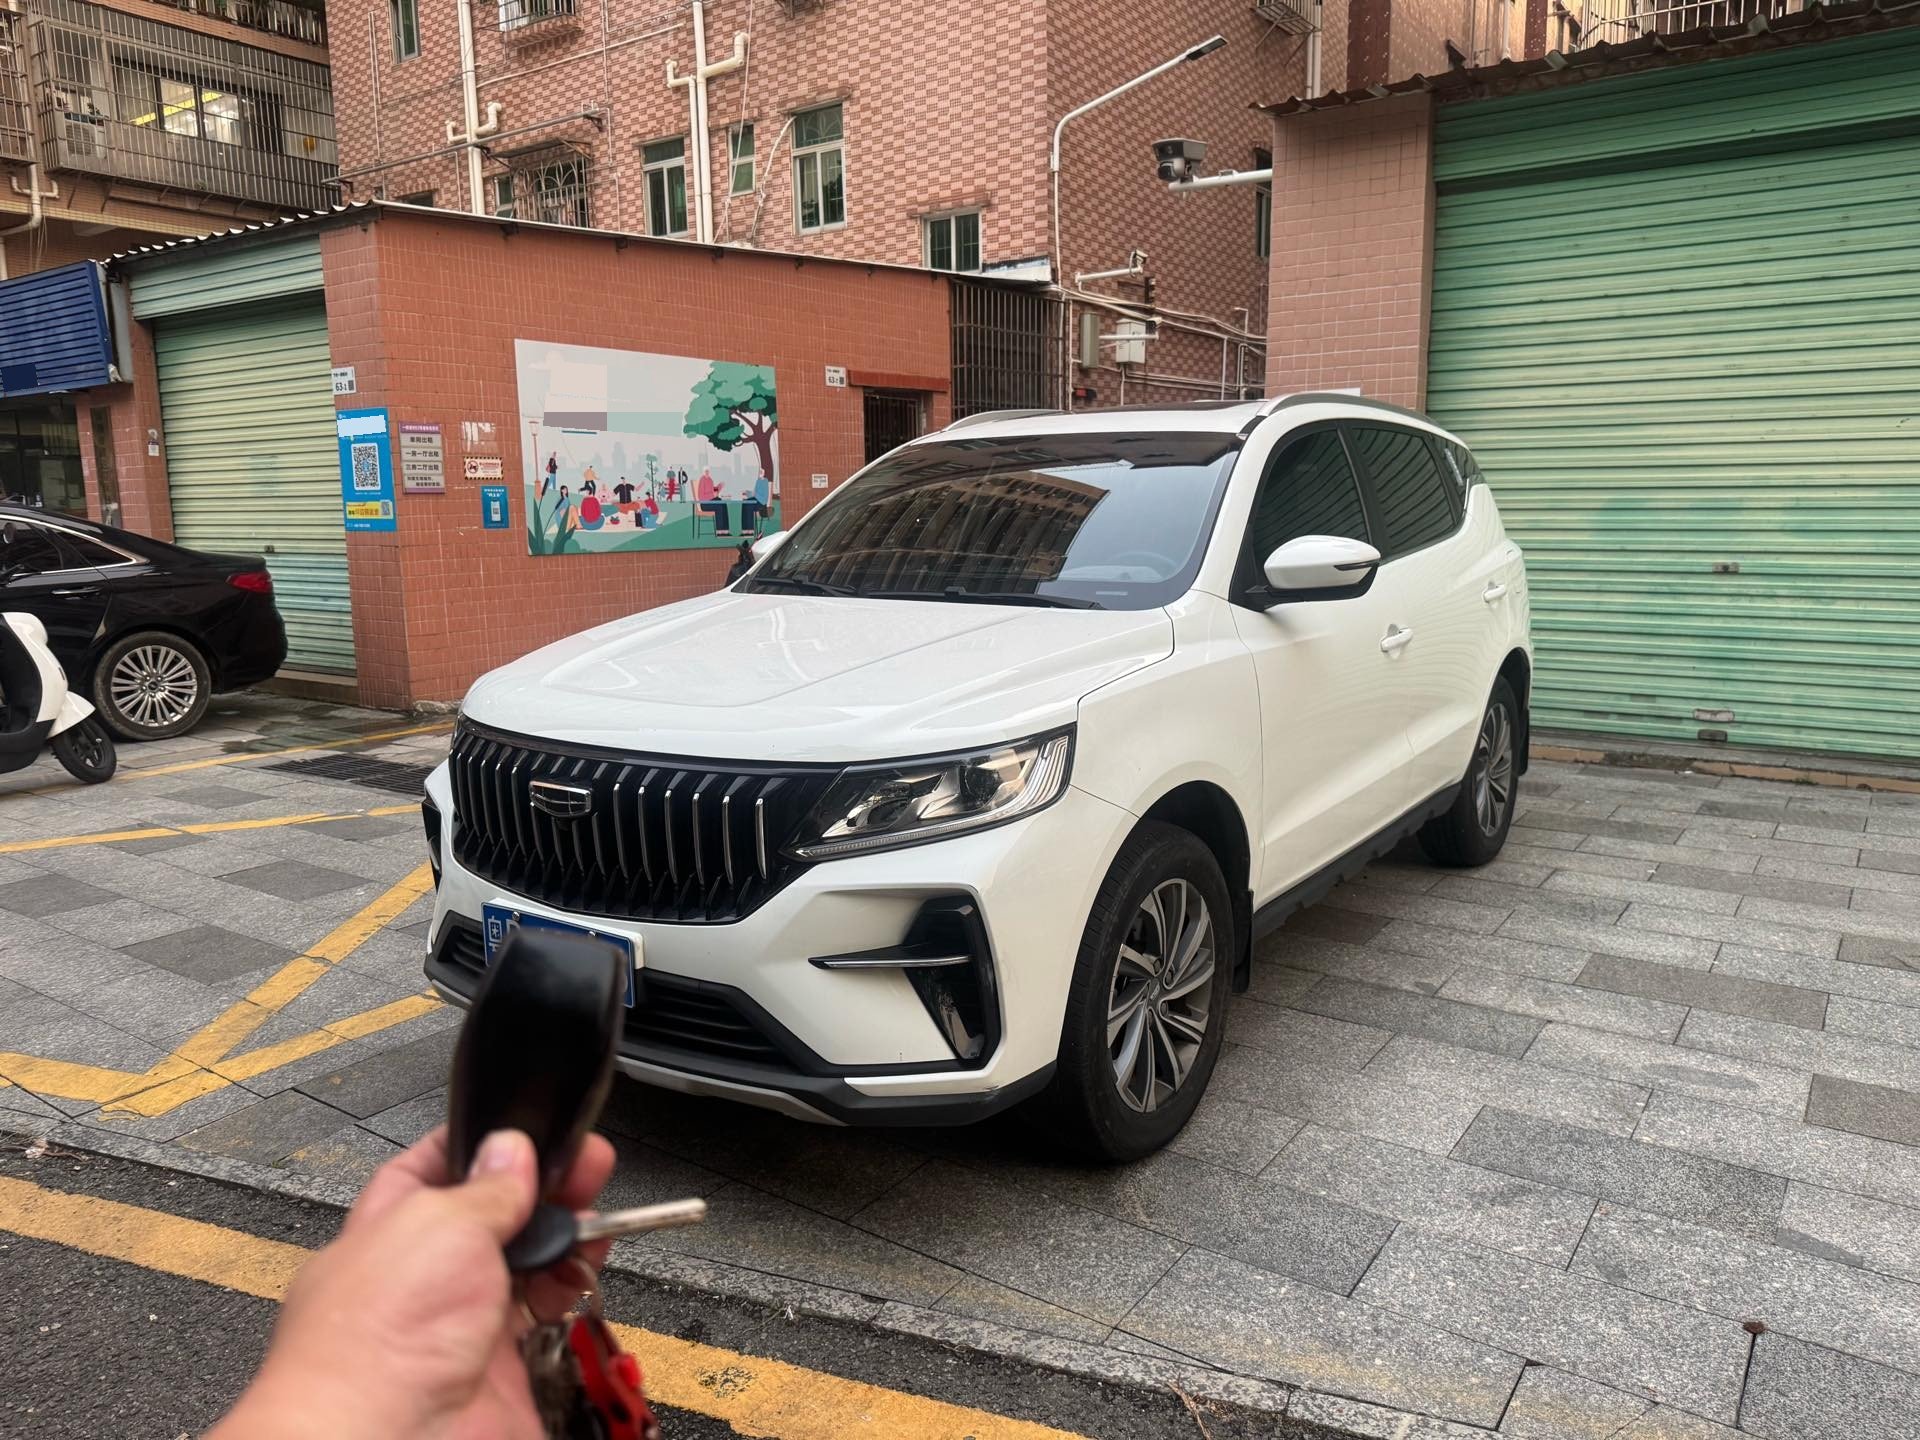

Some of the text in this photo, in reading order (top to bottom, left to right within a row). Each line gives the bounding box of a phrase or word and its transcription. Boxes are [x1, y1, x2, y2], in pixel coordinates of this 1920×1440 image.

[405, 450, 440, 458] 一房一厅出租
